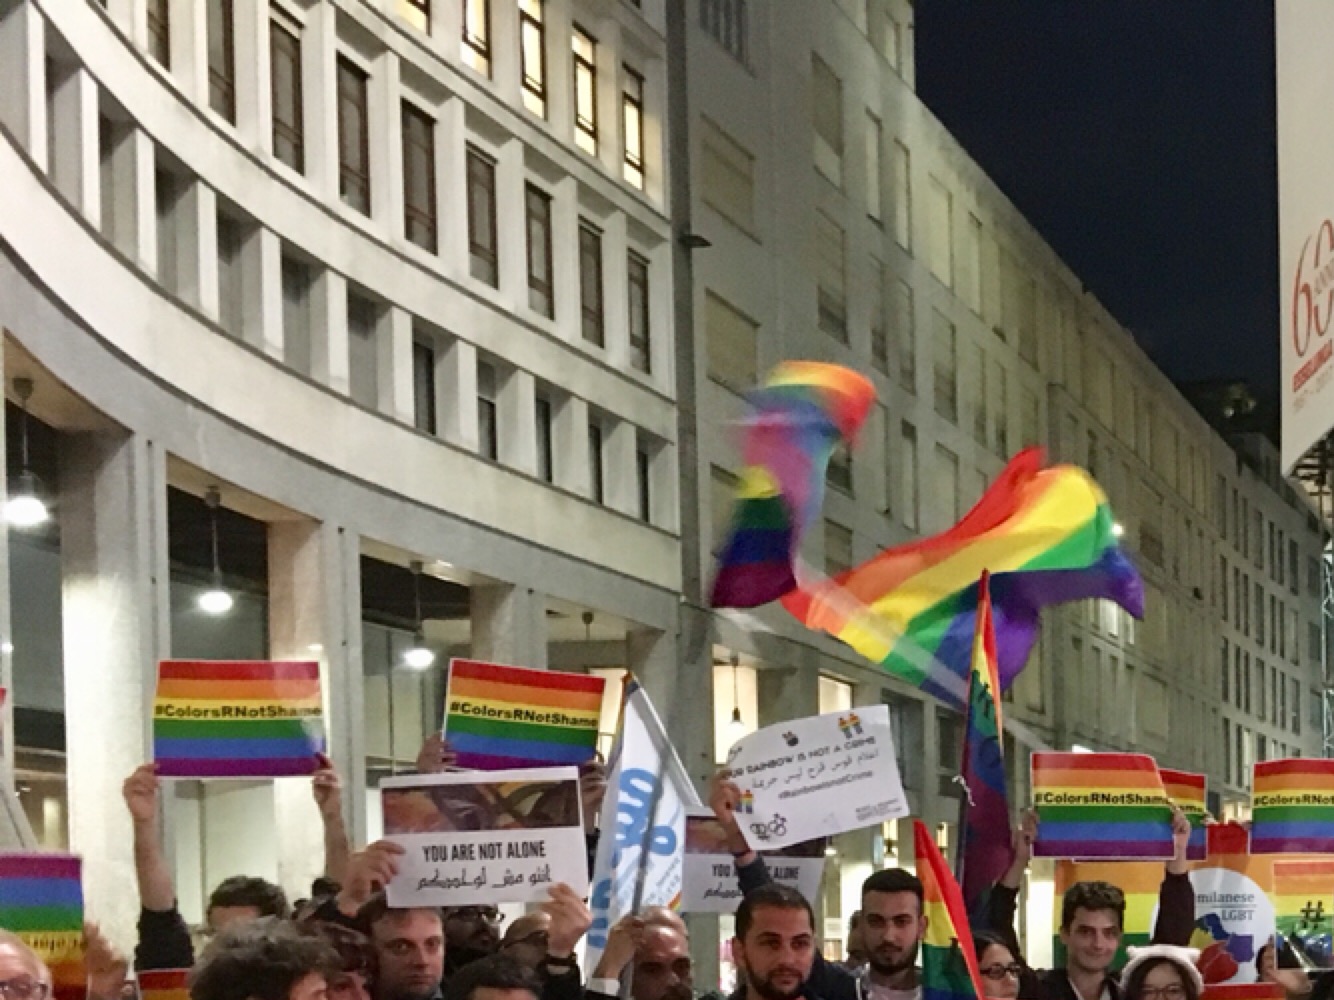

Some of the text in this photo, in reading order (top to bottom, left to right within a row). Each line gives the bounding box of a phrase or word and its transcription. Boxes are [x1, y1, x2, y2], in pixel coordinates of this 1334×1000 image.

[154, 703, 322, 719] #ColorsRNotShame
[449, 699, 599, 729] #ColorsRNotShame
[1034, 791, 1169, 805] #ColorsRNotSham
[422, 840, 546, 862] YOU ARE NOT ALONE
[1195, 892, 1255, 902] milanese
[1221, 909, 1254, 921] LGBT
